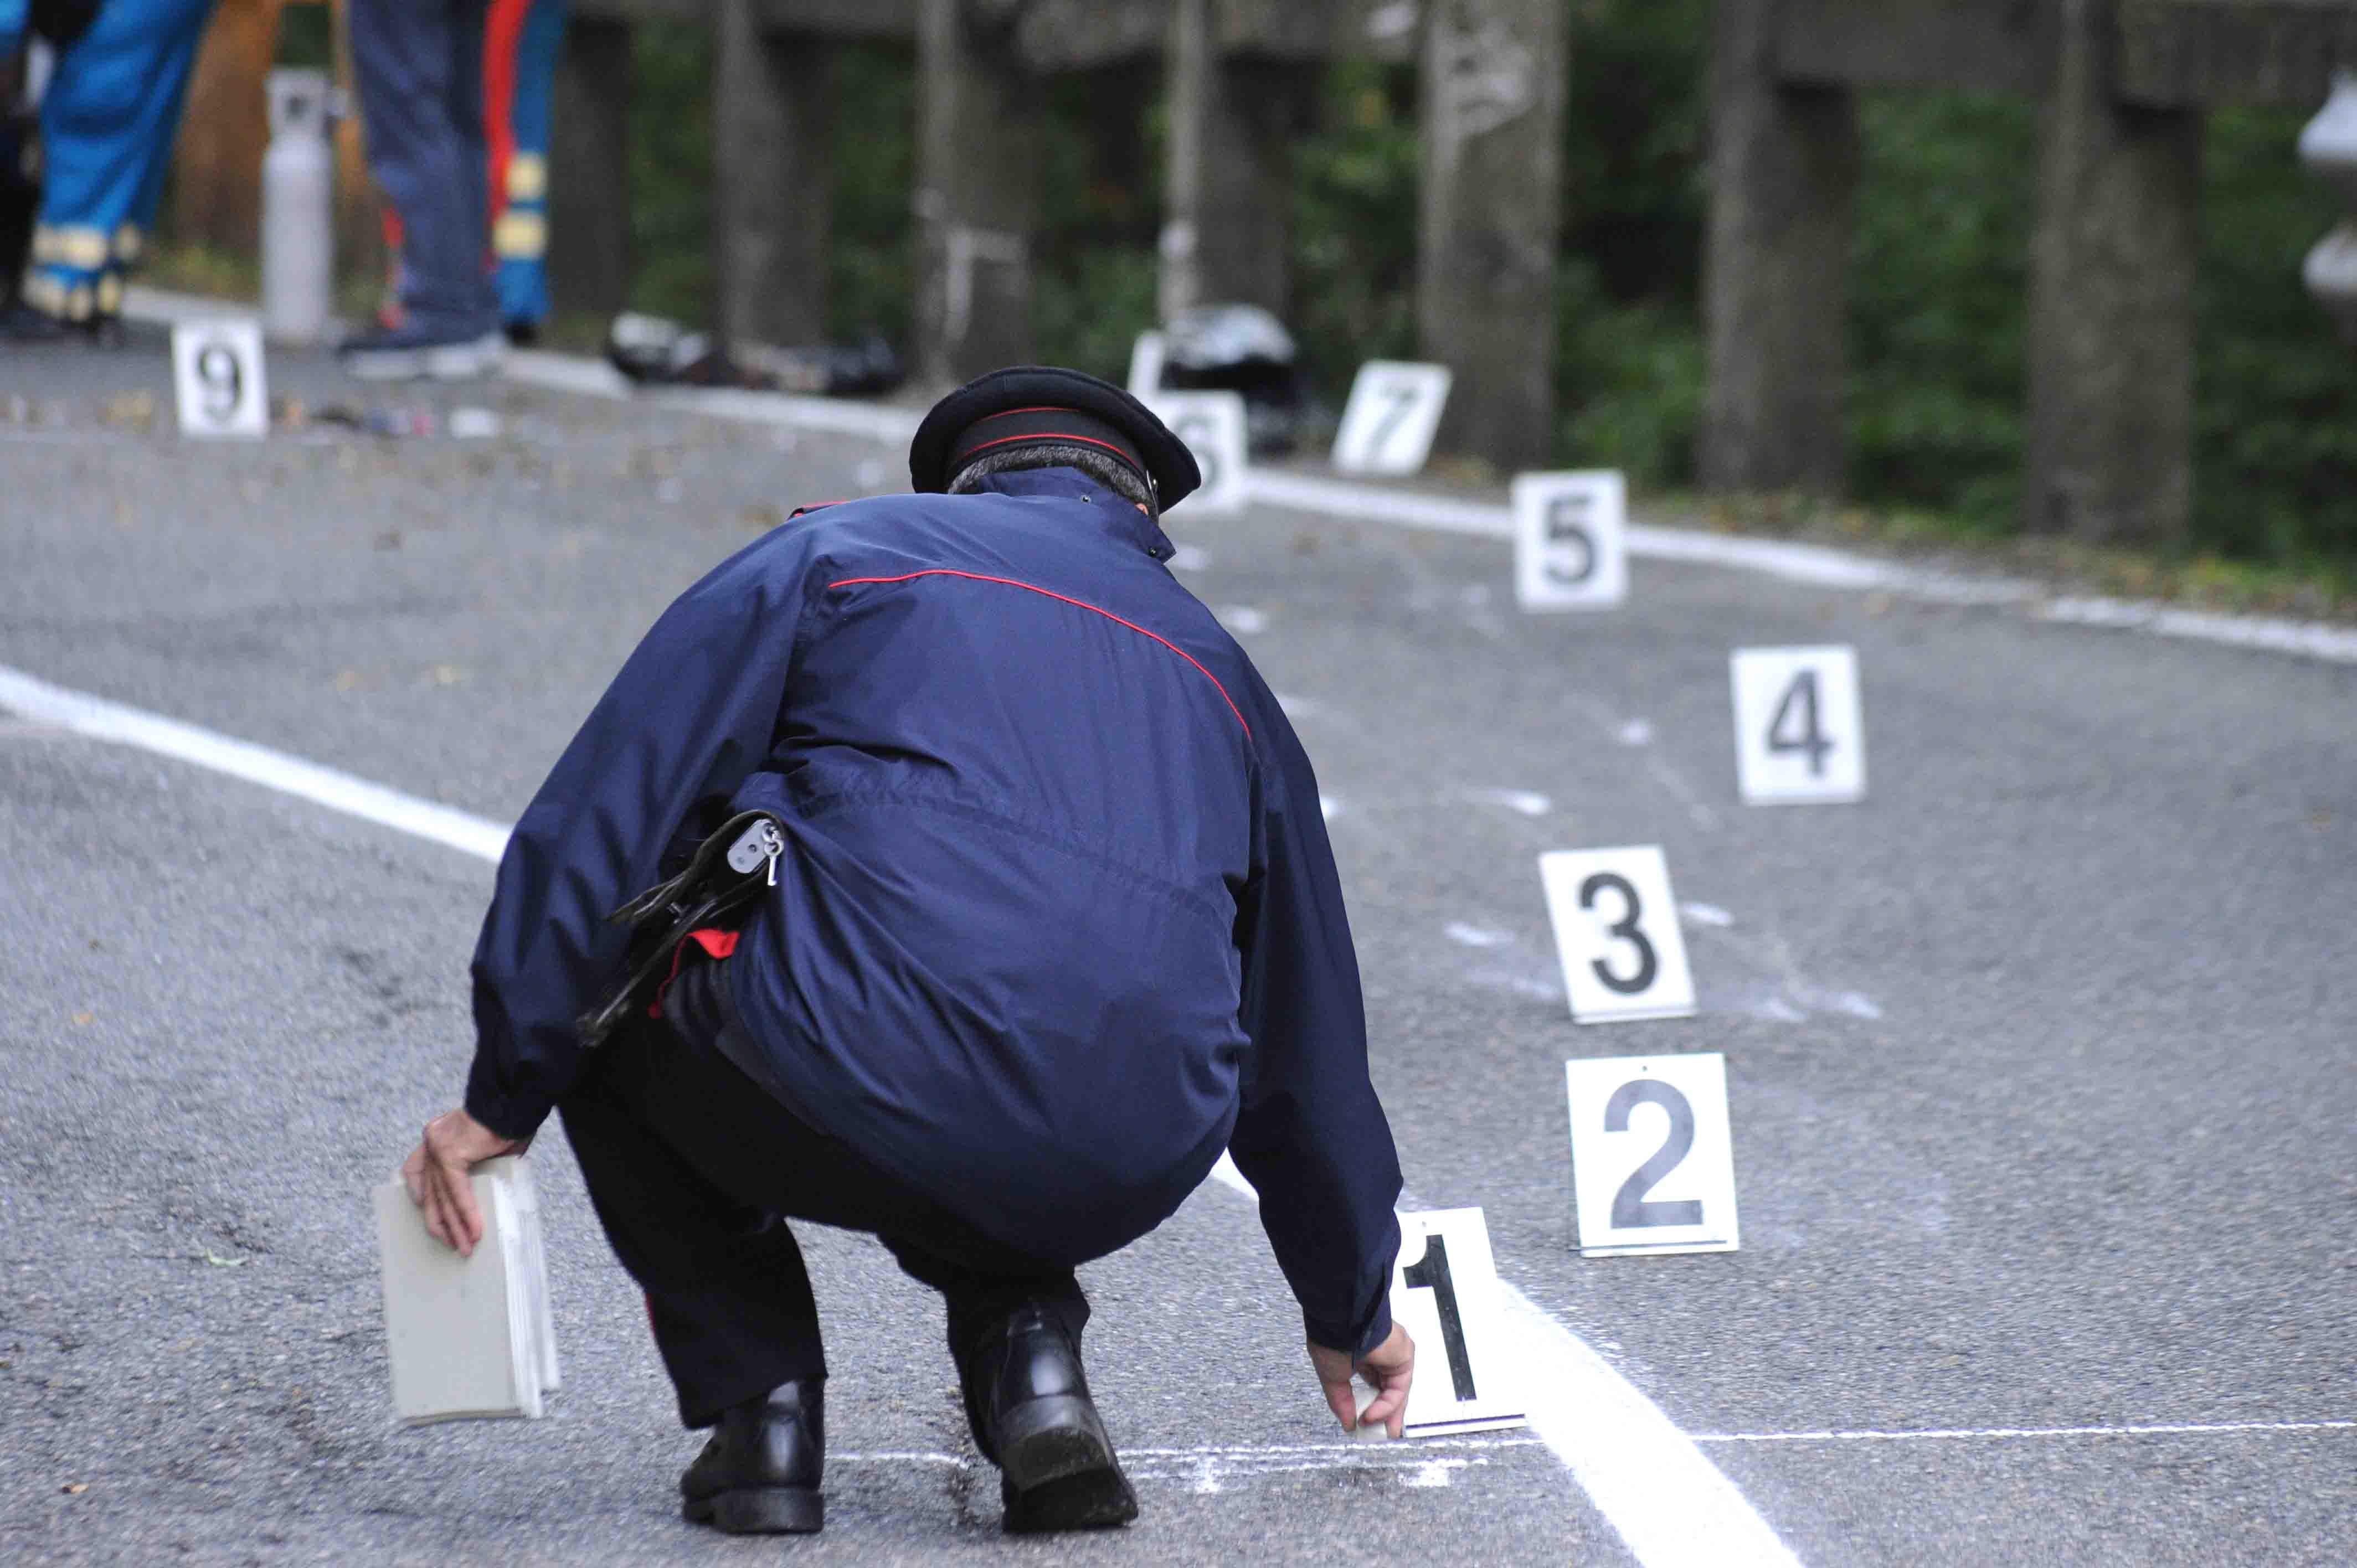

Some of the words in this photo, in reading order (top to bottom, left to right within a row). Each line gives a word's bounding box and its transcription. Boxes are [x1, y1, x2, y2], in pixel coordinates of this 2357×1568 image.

[194, 342, 243, 424] 9
[1361, 385, 1422, 464] 7
[1545, 496, 1596, 584] 5
[1768, 672, 1832, 775] 4
[1579, 873, 1658, 995] 3
[1604, 1079, 1704, 1230] 2
[1402, 1234, 1477, 1402] 1
